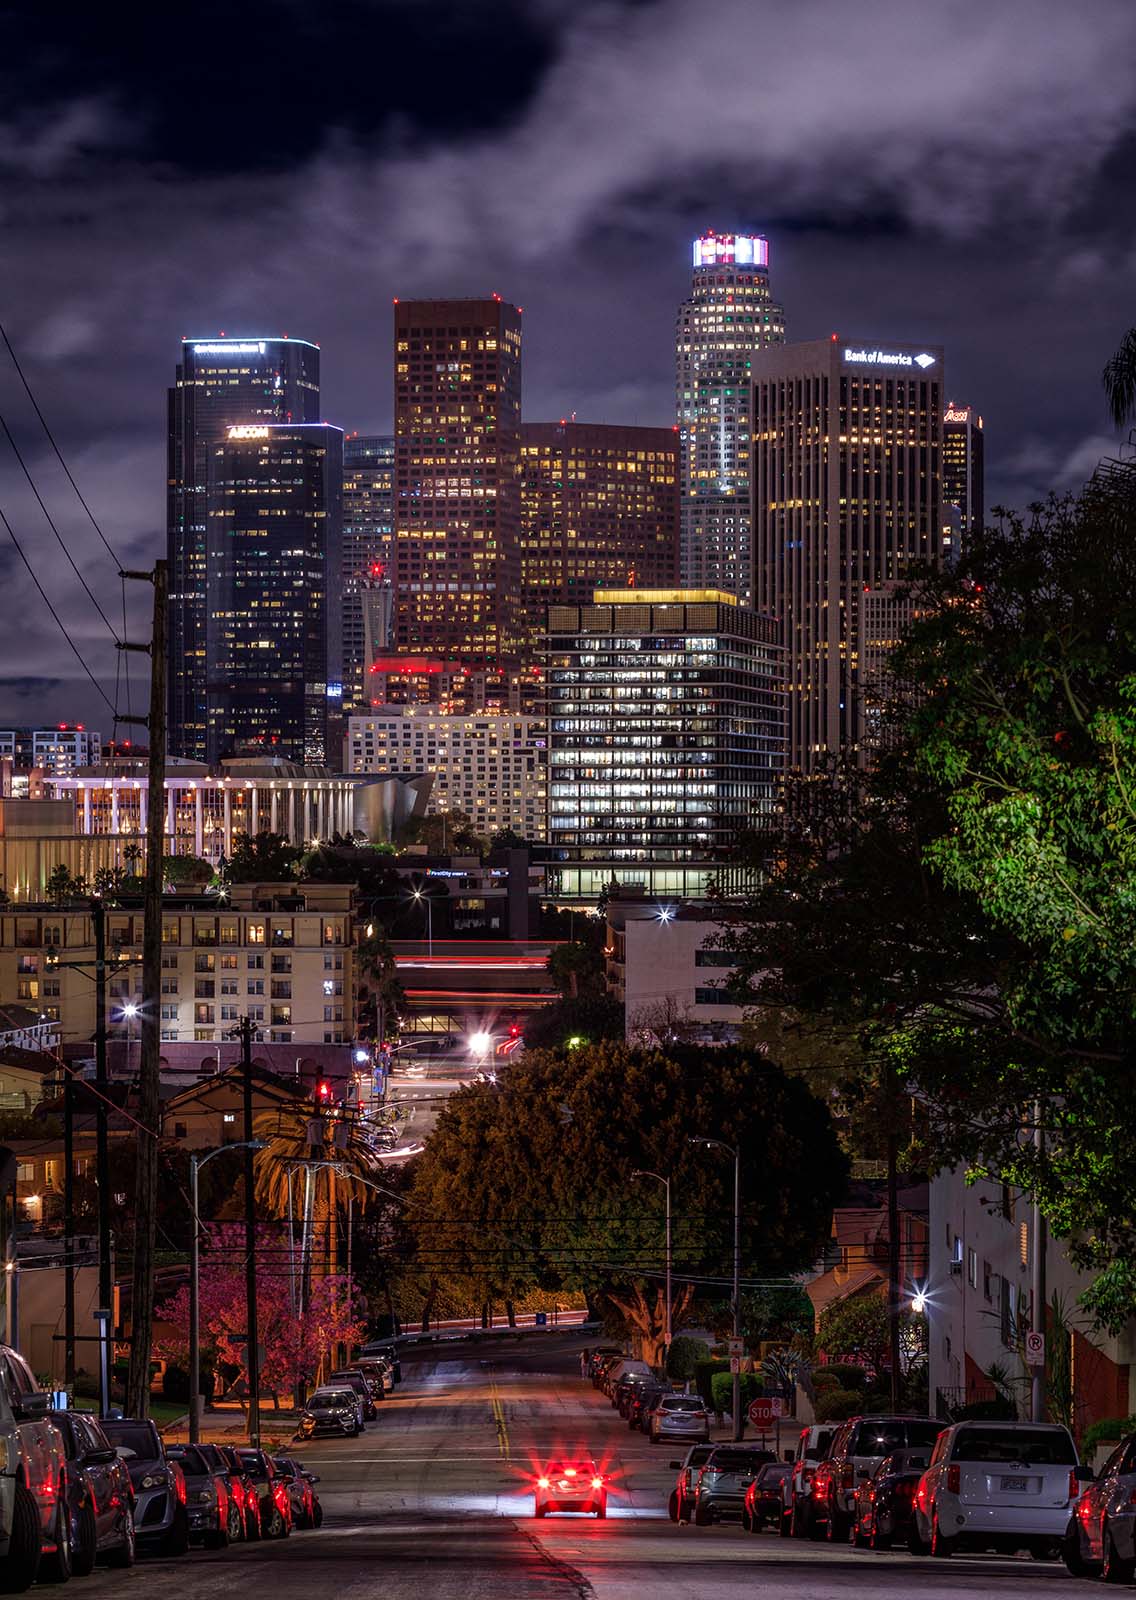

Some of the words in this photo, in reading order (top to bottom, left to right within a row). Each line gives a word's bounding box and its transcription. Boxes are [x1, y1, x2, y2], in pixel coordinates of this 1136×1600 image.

[845, 349, 867, 362] Bank
[867, 351, 877, 363] of
[877, 352, 912, 365] America
